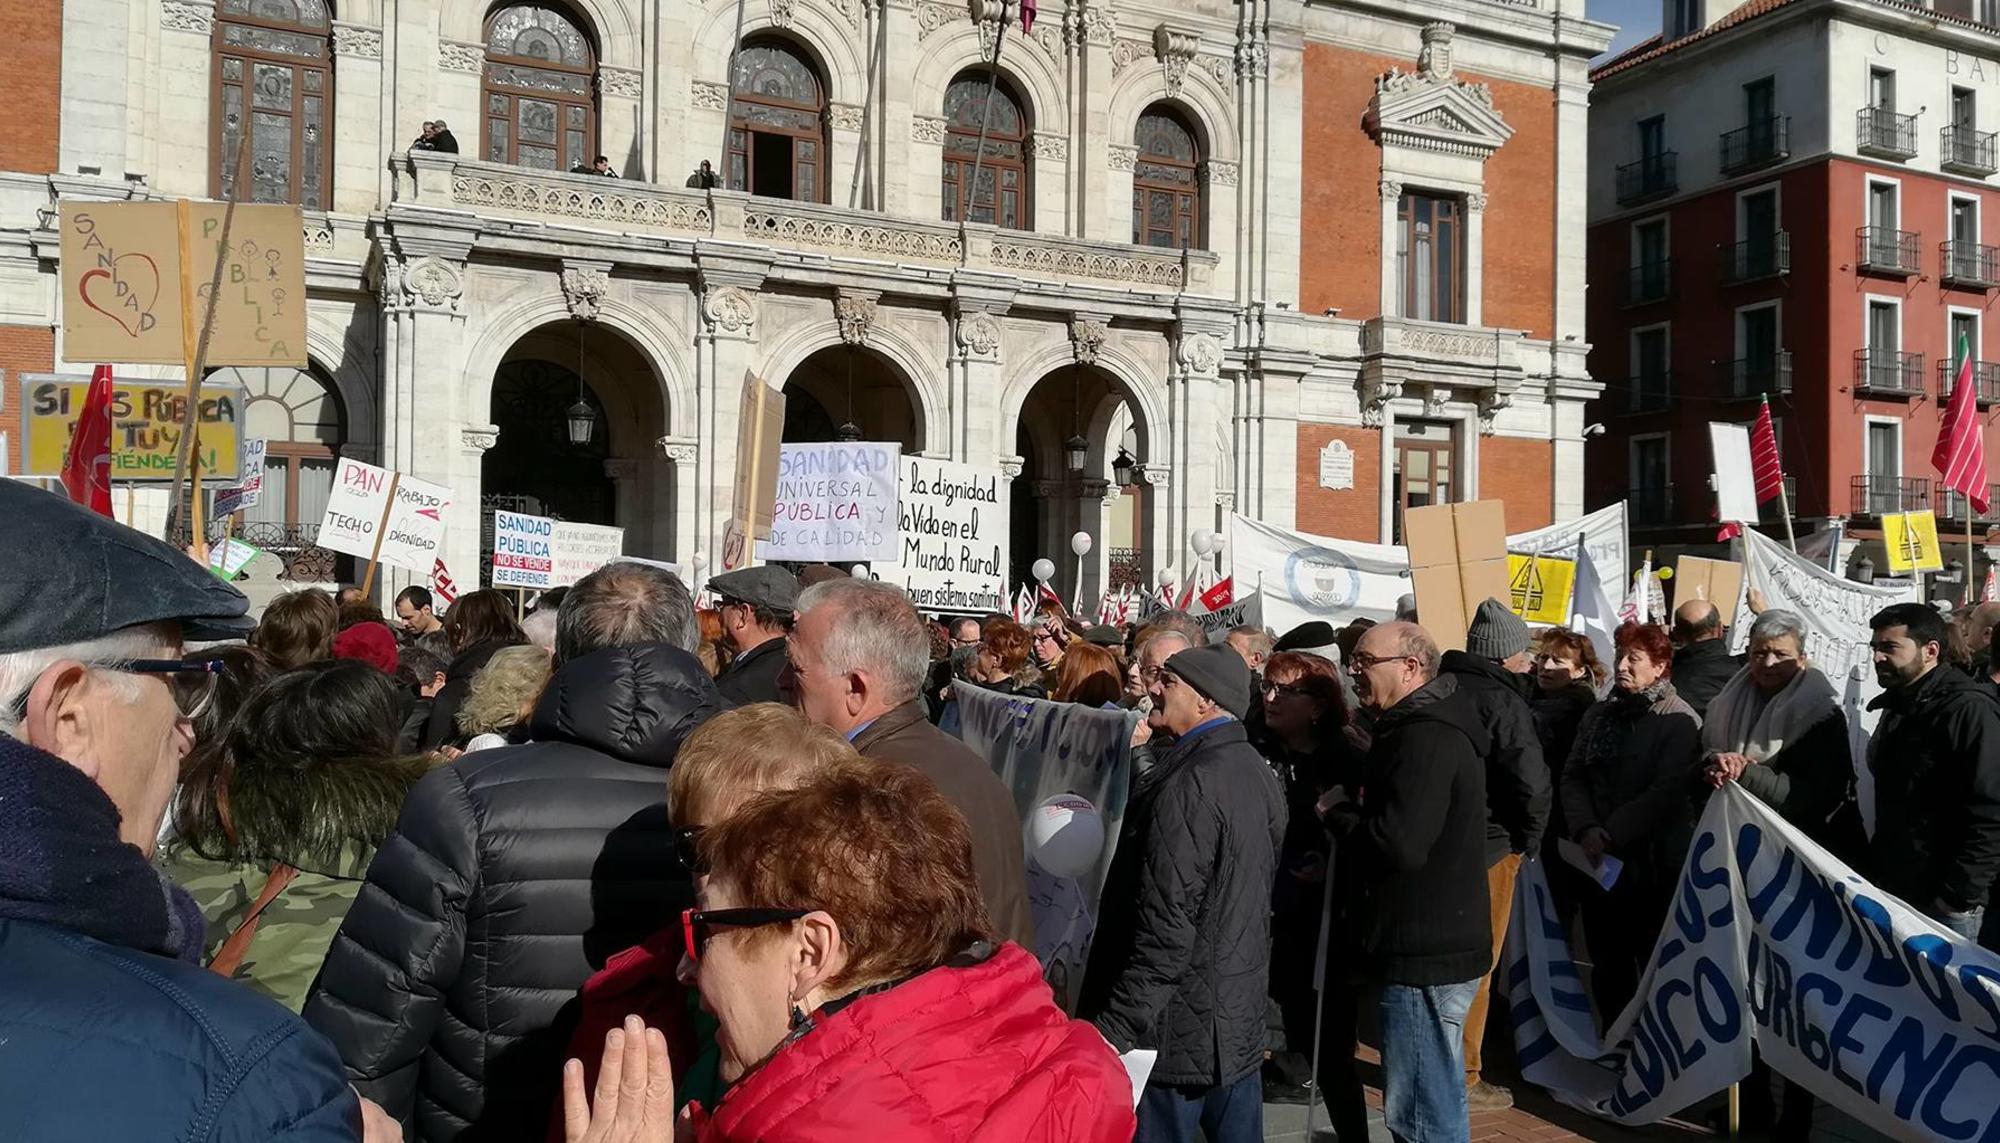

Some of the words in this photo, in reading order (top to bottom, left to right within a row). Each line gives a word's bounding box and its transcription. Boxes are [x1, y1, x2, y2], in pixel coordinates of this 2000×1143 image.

[74, 214, 155, 331] SANIDAD
[33, 383, 70, 416] SI
[111, 391, 133, 418] S
[144, 388, 234, 424] PÚBCA
[116, 420, 182, 454] TUY
[780, 447, 888, 477] SANIDAD
[344, 464, 385, 493] PAN
[910, 461, 928, 494] la
[931, 467, 997, 507] dignidad
[397, 485, 440, 507] RABAJO
[328, 511, 373, 534] TECHO
[499, 513, 551, 537] SANIDAD
[773, 500, 860, 523] PÚBLICA
[875, 505, 887, 524] Y
[911, 503, 940, 534] Vida
[942, 520, 958, 539] en
[960, 507, 979, 540] el
[389, 530, 436, 550] DIGNIDAD
[498, 533, 550, 557] PÚBLICA
[772, 529, 787, 546] DE
[796, 527, 884, 547] CALIDAD
[496, 554, 511, 566] NO
[512, 556, 525, 567] SE
[525, 557, 550, 571] VENDE
[902, 536, 955, 572] Mundo
[960, 545, 1001, 577] Rural
[496, 569, 509, 581] SE
[511, 570, 549, 585] DEFIENDE
[906, 575, 933, 605] buen
[935, 579, 967, 608] sistema
[1748, 930, 2000, 1143] URGENC
